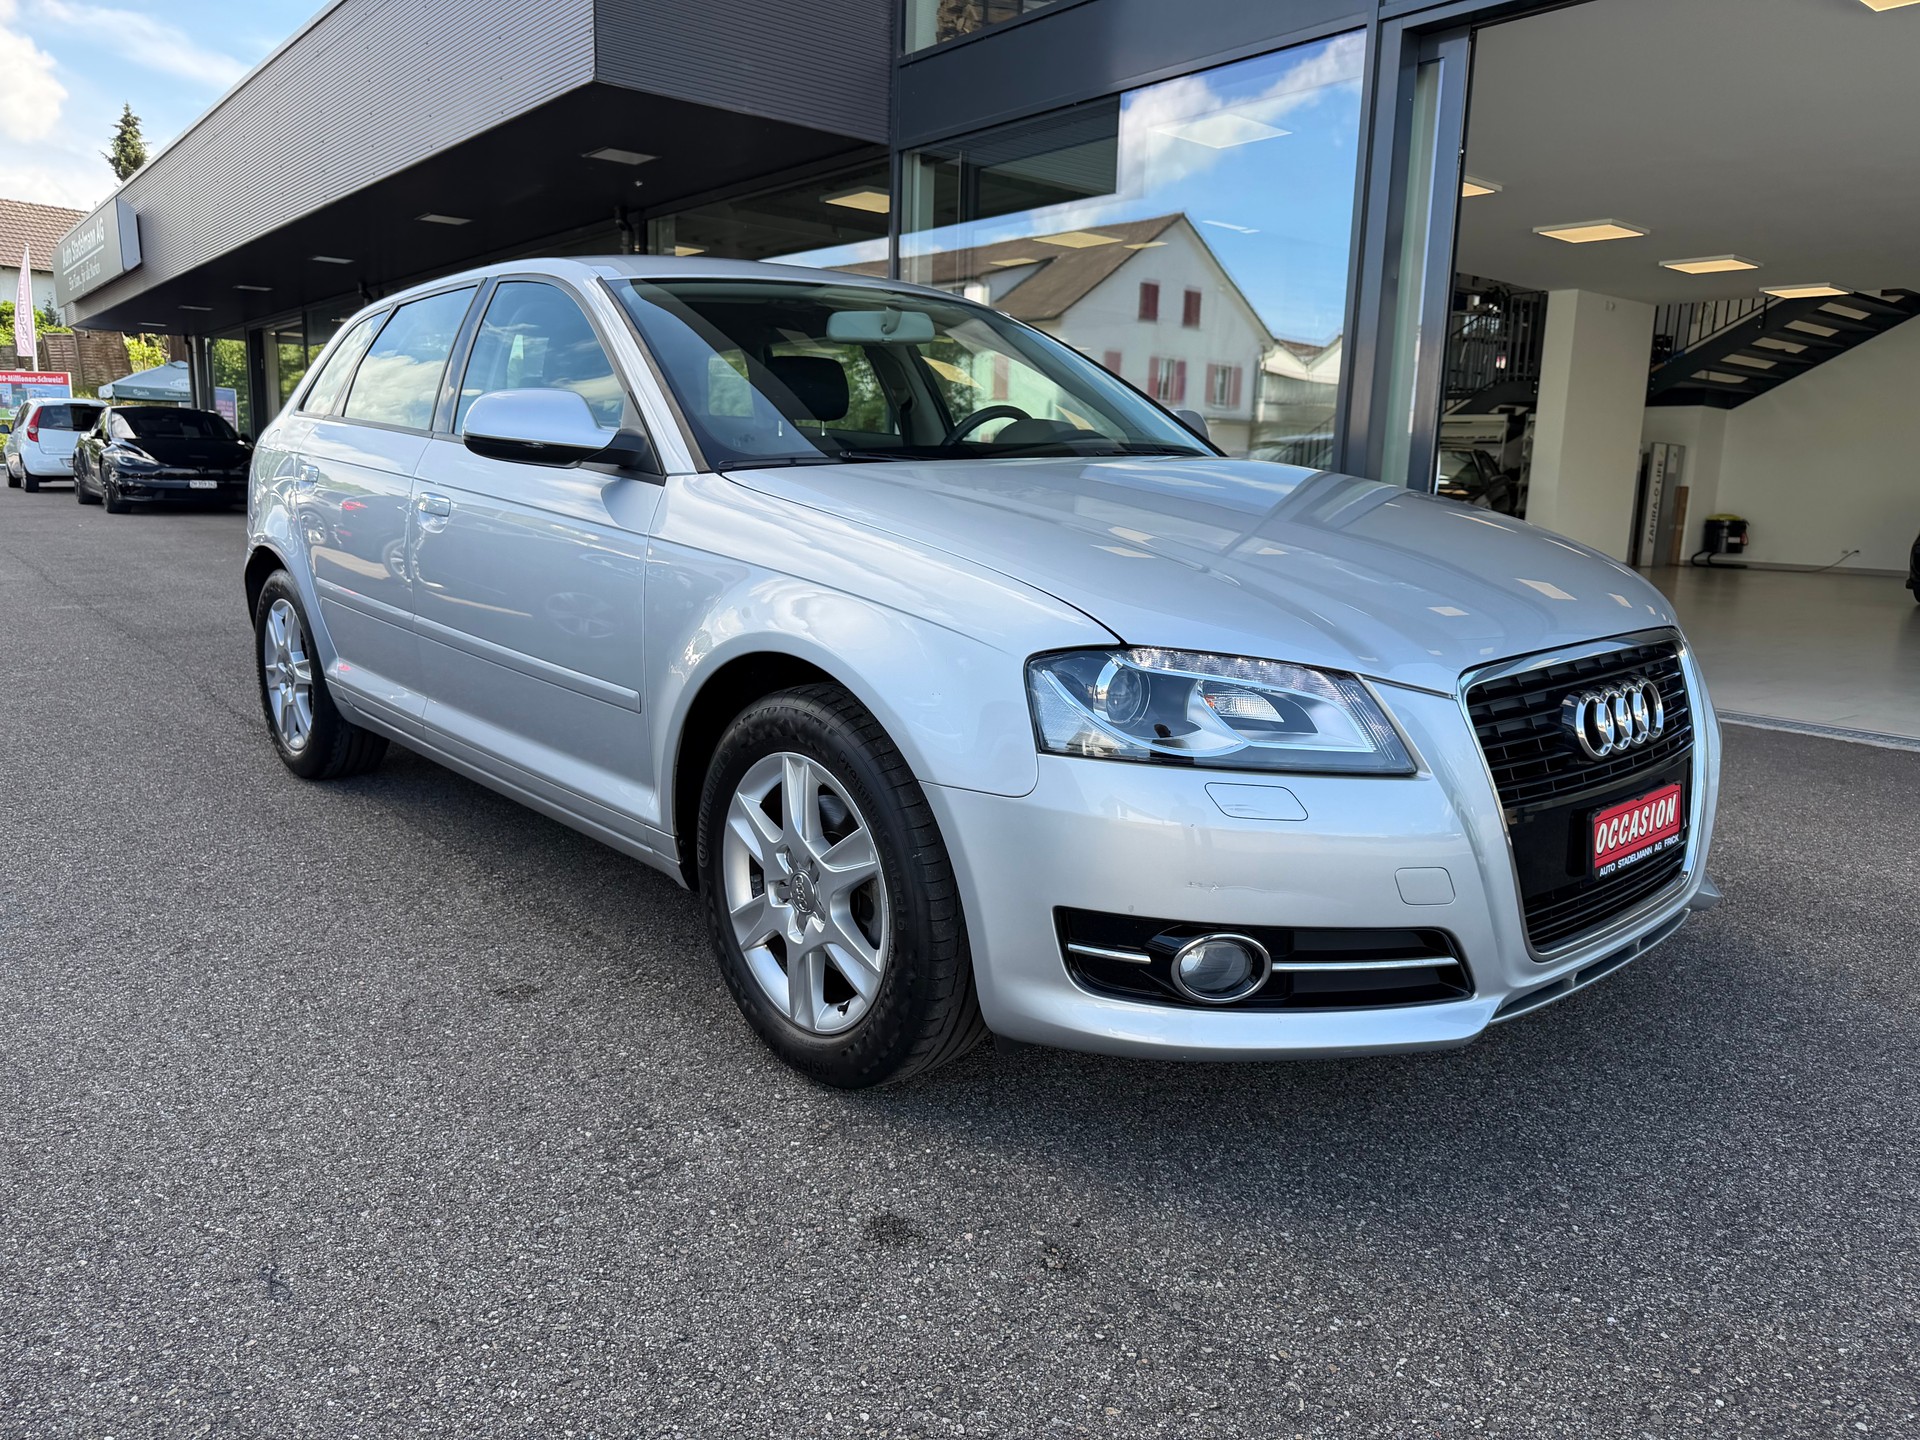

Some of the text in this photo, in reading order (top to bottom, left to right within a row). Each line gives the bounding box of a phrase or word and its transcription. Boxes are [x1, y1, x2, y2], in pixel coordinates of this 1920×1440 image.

[96, 216, 104, 244] AG
[1655, 460, 1663, 484] LIFE
[1596, 793, 1677, 854] OCCASION
[1599, 834, 1679, 877] AUTO STADELMANN AG FRICK
